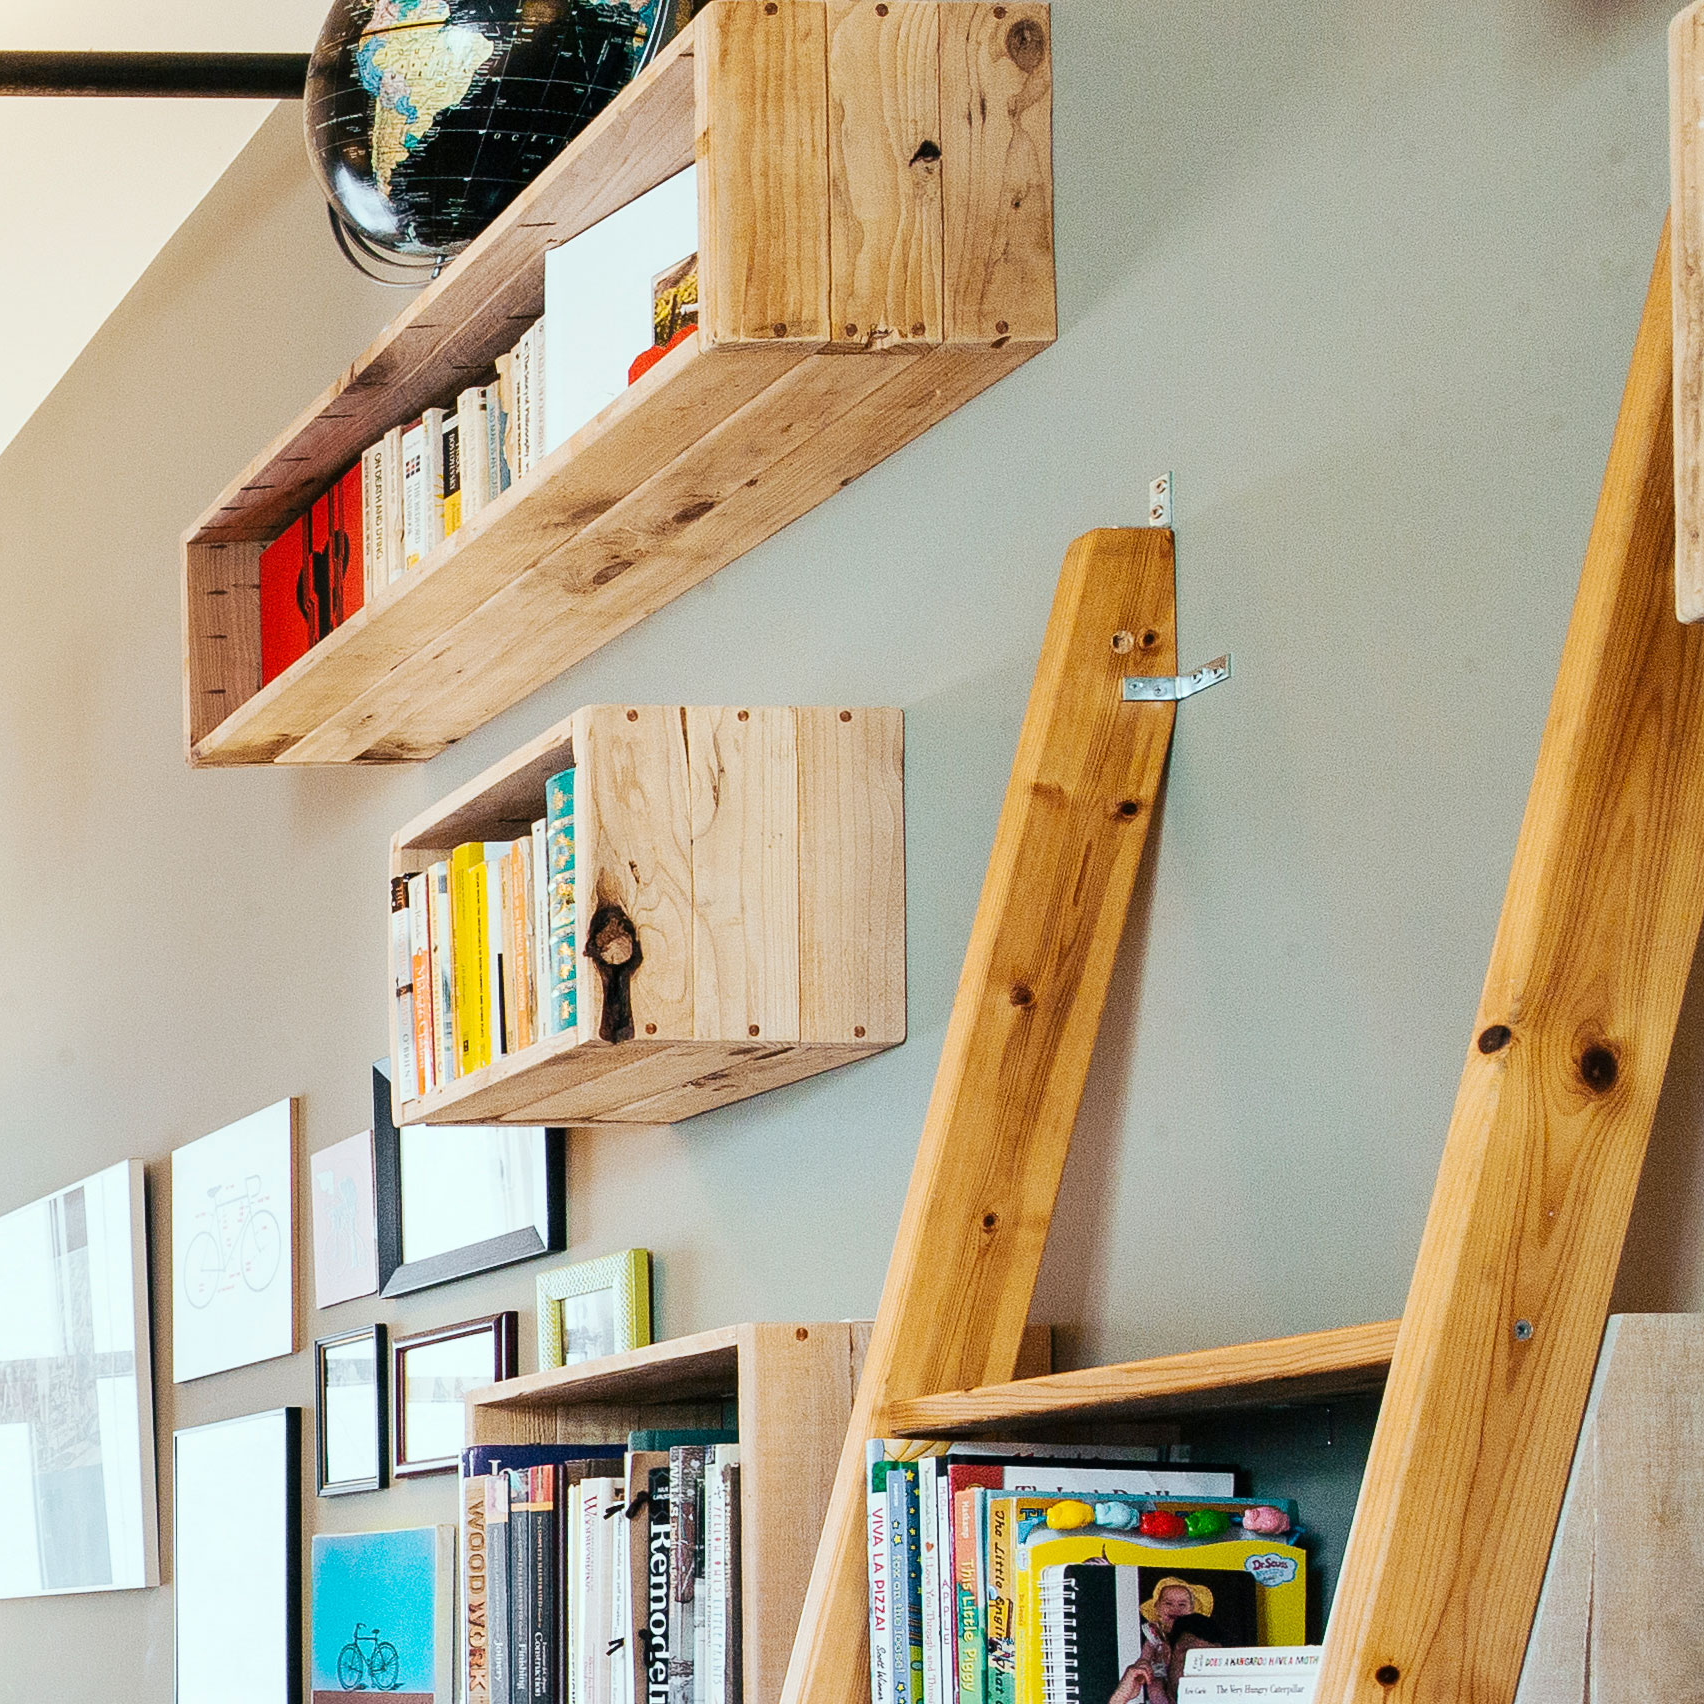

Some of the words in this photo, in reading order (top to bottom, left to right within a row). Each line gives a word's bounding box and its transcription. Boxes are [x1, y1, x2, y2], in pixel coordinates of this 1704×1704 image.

[494, 133, 570, 145] OCEA
[375, 452, 382, 468] ON
[375, 470, 383, 503] DEATH
[375, 505, 383, 526] AND
[376, 528, 384, 560] DYING
[402, 1034, 411, 1078] O'BRIEN
[670, 1460, 680, 1517] WALLS
[713, 1506, 724, 1553] YELLOW
[871, 1507, 884, 1547] VIVA
[962, 1500, 970, 1539] Haskamp
[994, 1510, 1006, 1536] The
[466, 1501, 485, 1595] WOOD
[872, 1552, 884, 1574] LA
[994, 1542, 1006, 1589] Little
[893, 1581, 903, 1600] on
[925, 1562, 934, 1587] Love
[962, 1559, 975, 1591] This
[873, 1579, 885, 1632] PIZZA!
[925, 1589, 934, 1609] You
[963, 1594, 976, 1642] Little
[924, 1611, 935, 1652] Through
[994, 1596, 1007, 1652] Engine
[468, 1601, 488, 1692] WORK
[493, 1640, 504, 1683] Joinery
[534, 1632, 543, 1697] Construction
[875, 1644, 887, 1669] Scott
[927, 1655, 935, 1672] and
[1205, 1656, 1222, 1667] DOES
[1224, 1656, 1229, 1666] A
[1230, 1655, 1267, 1666] KANGAROO
[516, 1643, 527, 1691] Finishing
[960, 1648, 976, 1693] Piggy
[994, 1658, 1008, 1697] That
[1216, 1685, 1228, 1693] The
[1230, 1685, 1243, 1696] Very
[1244, 1685, 1268, 1696] Hungry
[1269, 1684, 1304, 1694] Caterpillar
